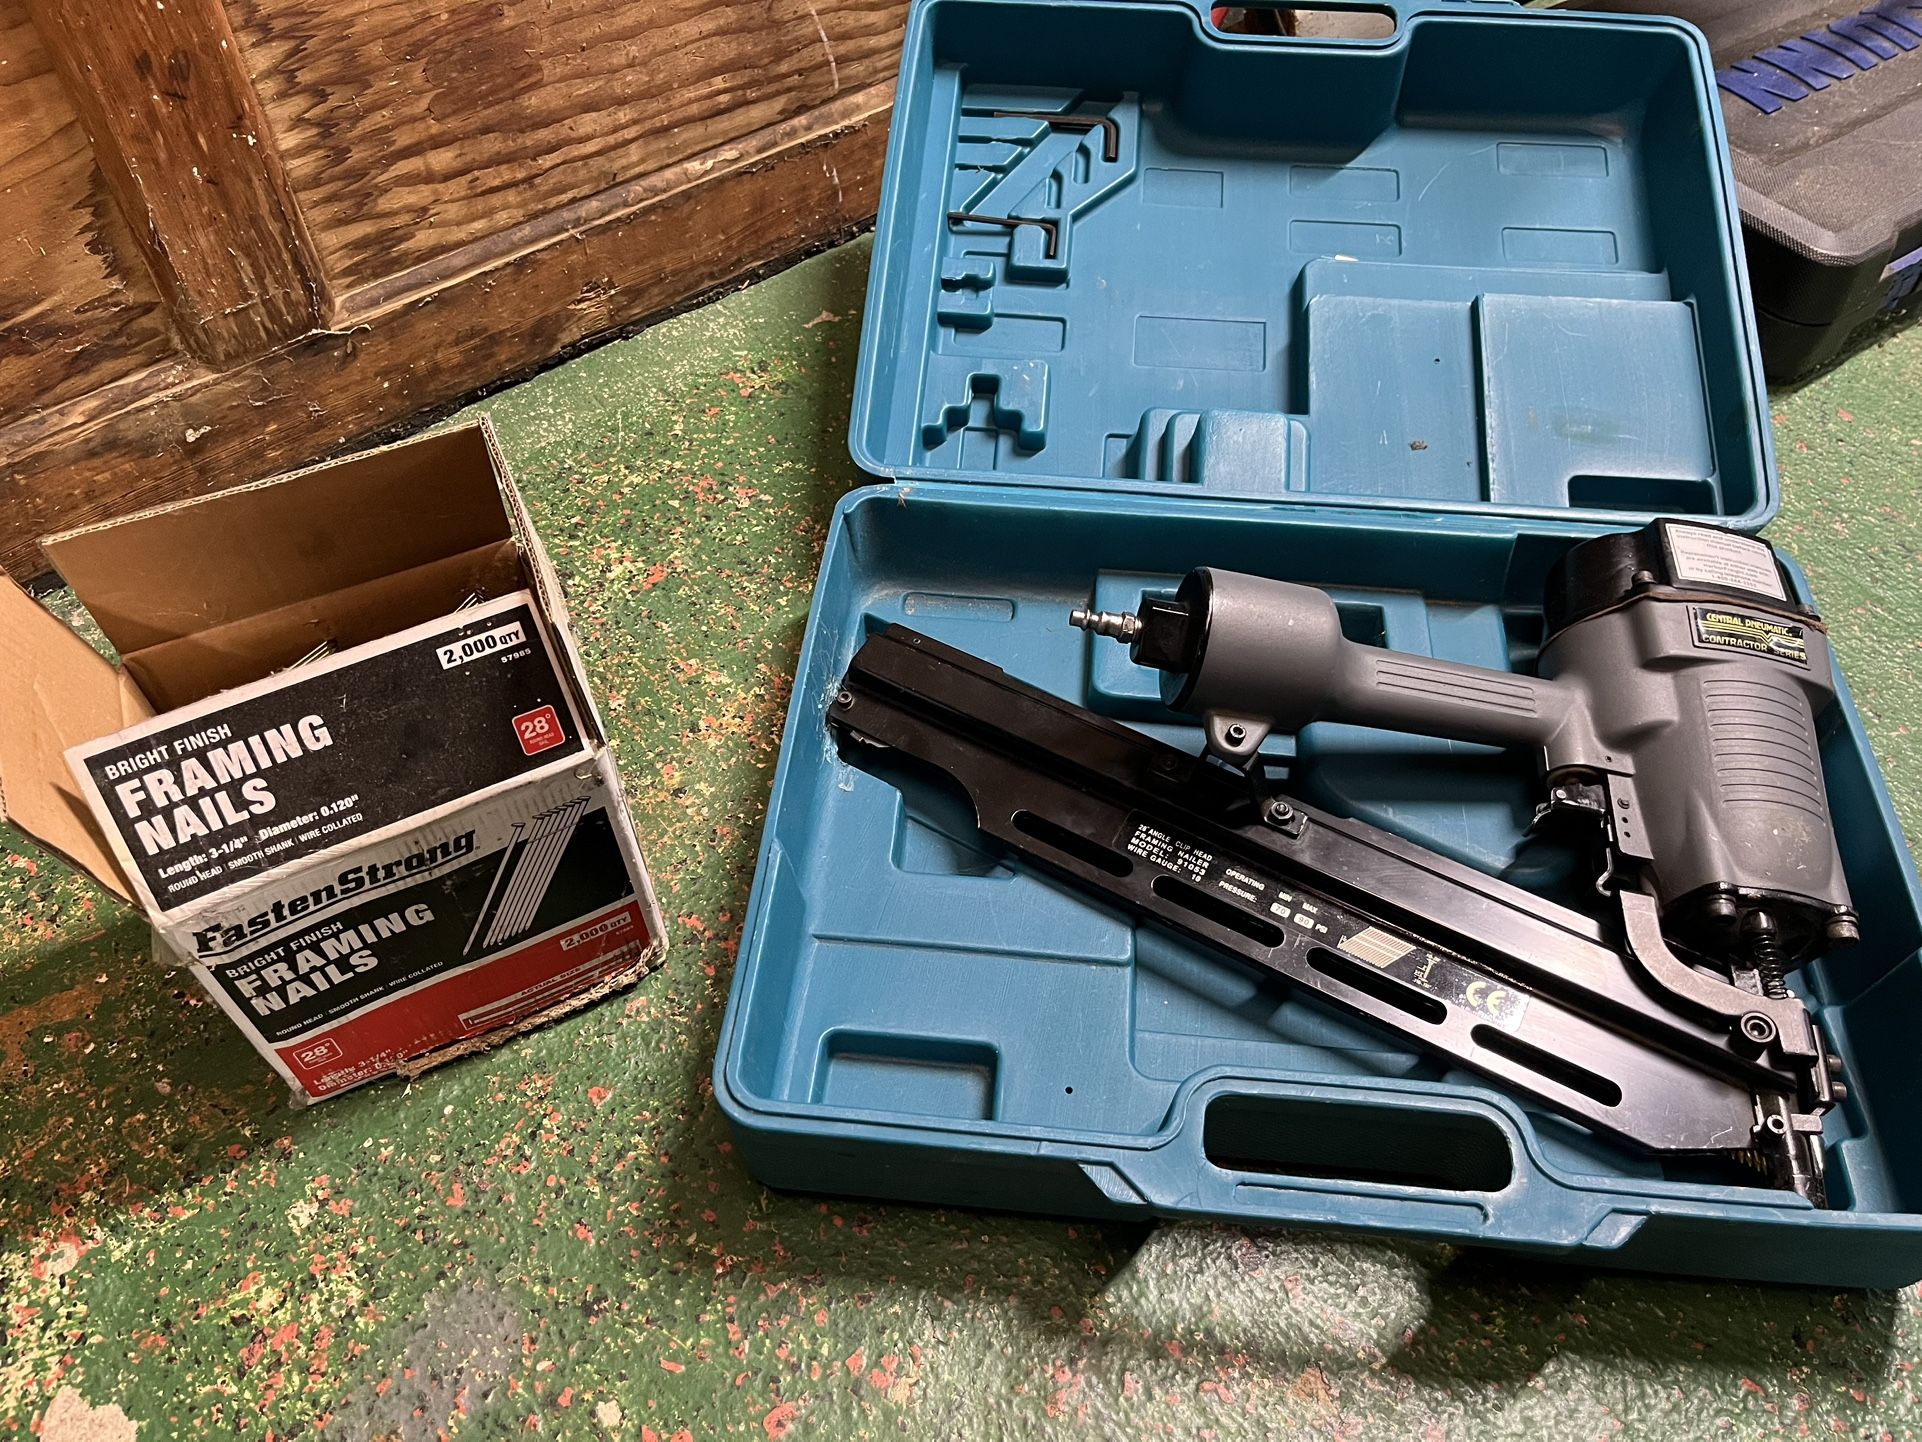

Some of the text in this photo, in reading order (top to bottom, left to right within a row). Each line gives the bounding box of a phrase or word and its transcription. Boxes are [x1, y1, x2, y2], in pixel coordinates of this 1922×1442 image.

[1706, 613, 1743, 626] CENTRAL
[443, 629, 520, 665] 2,000 QTY
[500, 648, 532, 664] 57985
[1702, 634, 1807, 660] CONTRACTOR SERIES
[520, 713, 551, 740] 28°
[104, 723, 233, 780] BRIGHT FINISH
[115, 714, 334, 819] FRAMING
[134, 778, 276, 856] NAILS
[158, 794, 360, 879] Length: 3-1/4" Diameter: 0.120"
[168, 812, 364, 894] ROUND HEAD SMOOTH SHANK WIRE COLLATED
[1134, 831, 1210, 869] FRAMING NAILER
[1148, 829, 1172, 843] ANGLE
[1175, 840, 1191, 851] CLIP
[1193, 848, 1213, 862] HEAD
[1127, 844, 1202, 883] WIRE GAUGE: 10
[1130, 837, 1206, 876] MODEL: 91053
[192, 829, 476, 954] FastenStrong
[1218, 880, 1258, 903] PRESSURE:
[1225, 868, 1265, 891] OPERATING
[1302, 902, 1319, 914] MAX
[225, 921, 344, 978] BRIGHT FINISH
[234, 903, 435, 999] FRAMING
[564, 916, 628, 949] 2,000 QTY
[250, 950, 379, 1016] NAILS
[276, 960, 444, 1037] ROUND HEAD SMOOTH SHANK WIRE COLLATED
[520, 967, 583, 996] ACTUAL SIZE
[300, 1042, 332, 1063] 28°
